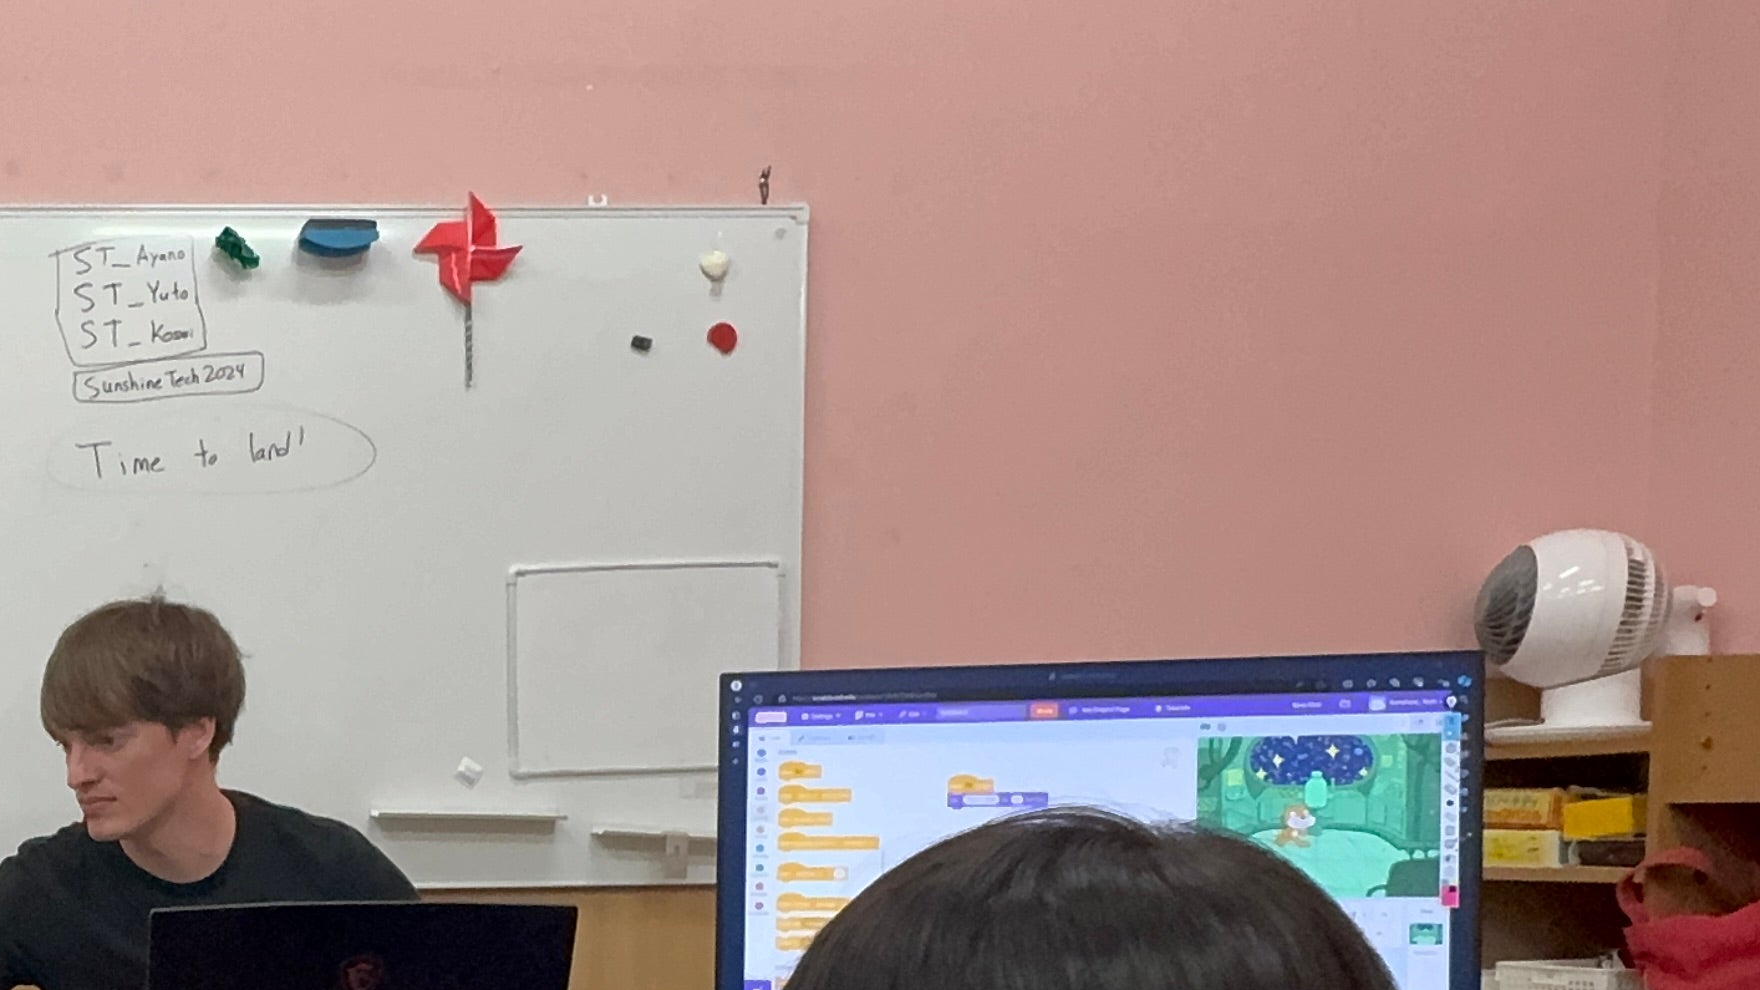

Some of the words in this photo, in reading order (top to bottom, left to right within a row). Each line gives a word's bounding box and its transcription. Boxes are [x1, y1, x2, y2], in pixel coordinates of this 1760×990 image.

[73, 279, 189, 313] ST_Yuto
[74, 440, 165, 479] Time
[193, 439, 219, 470] to
